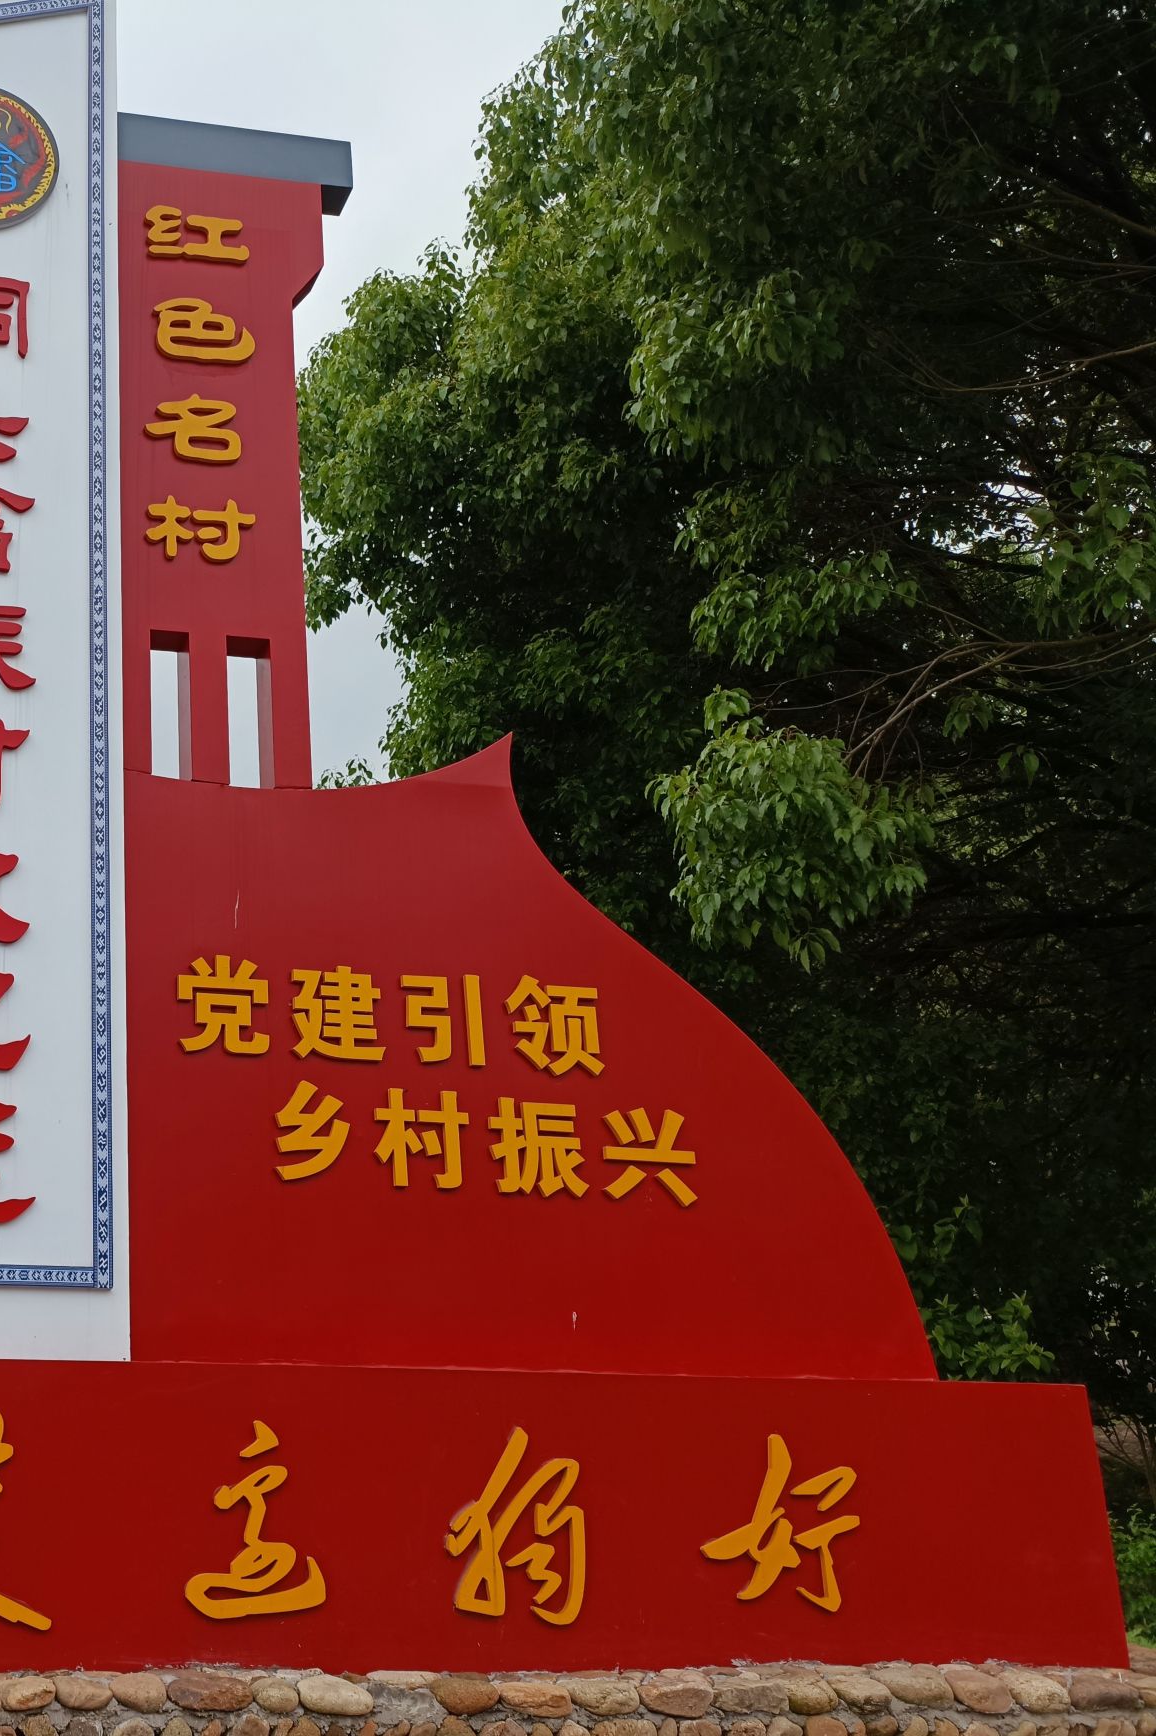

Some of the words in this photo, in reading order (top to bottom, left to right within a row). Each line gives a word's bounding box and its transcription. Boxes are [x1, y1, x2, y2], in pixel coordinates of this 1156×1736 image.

[145, 204, 257, 563] 红色名村
[176, 954, 606, 1077] 党建引领
[273, 1079, 698, 1208] 乡村振兴
